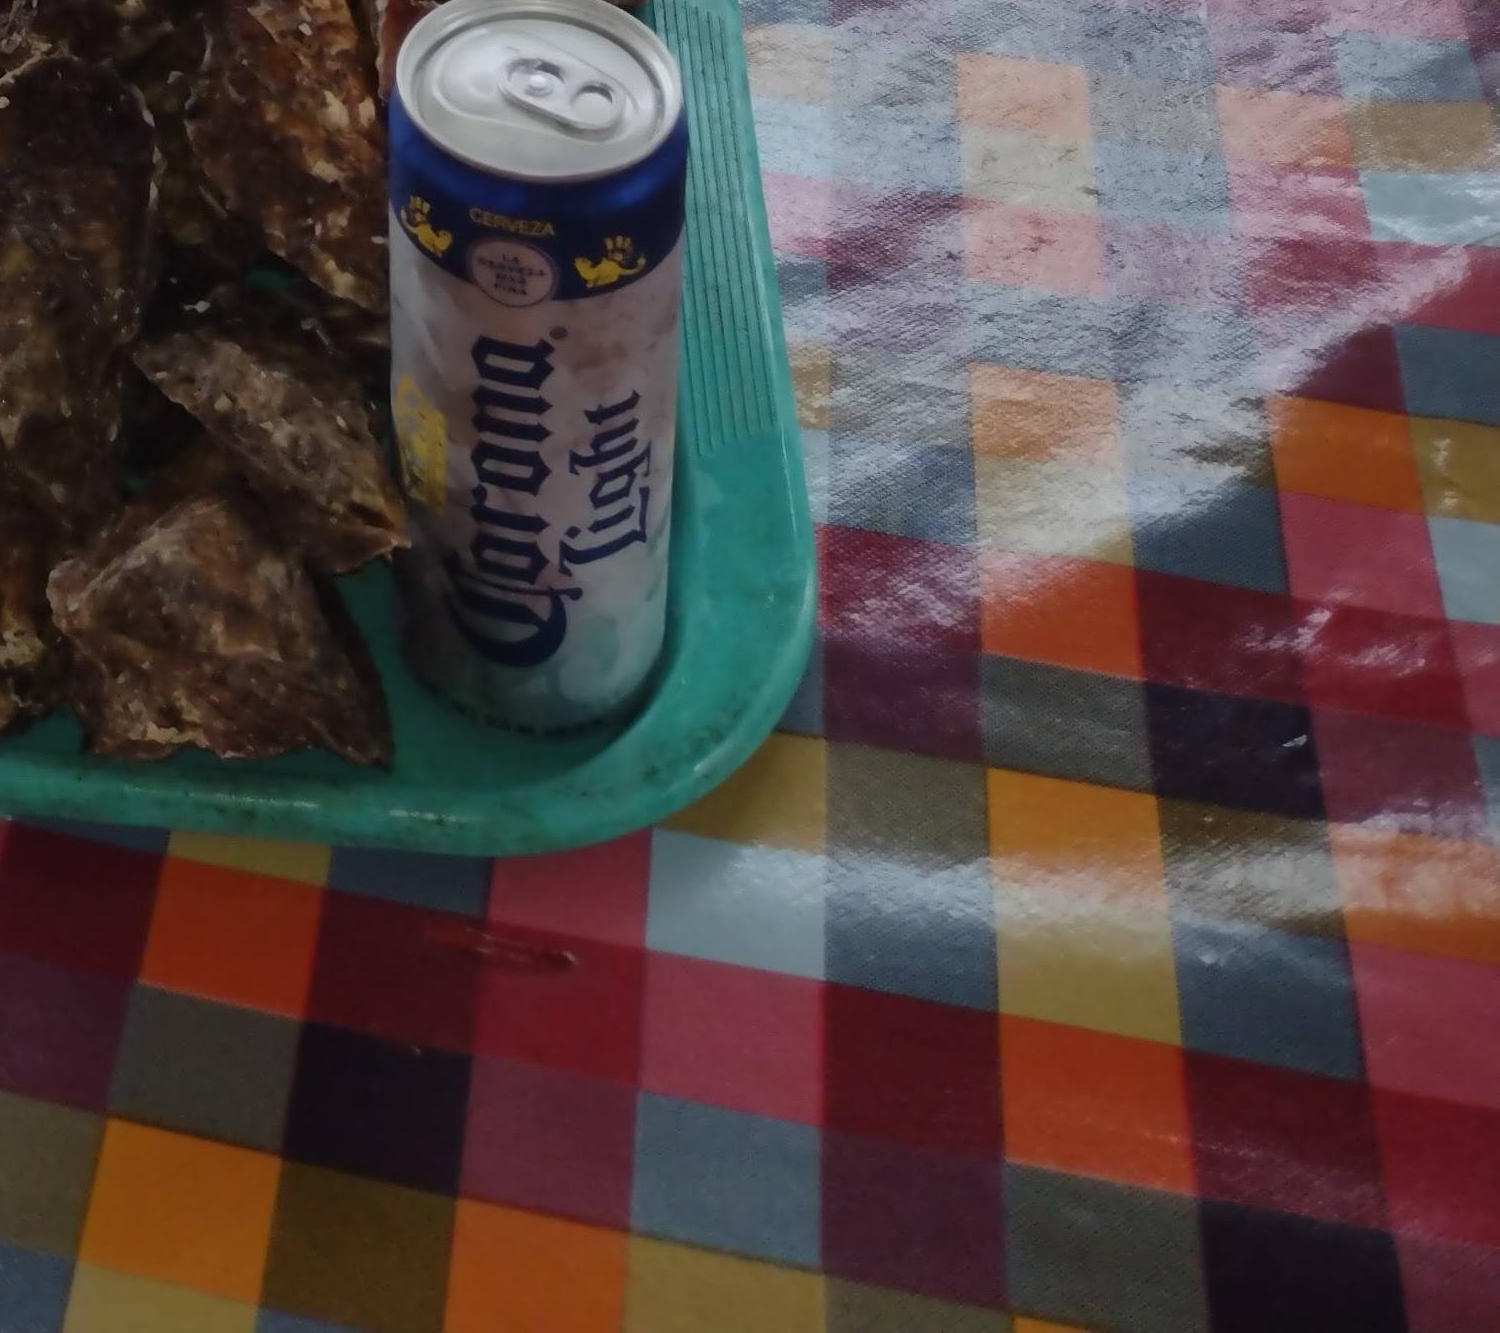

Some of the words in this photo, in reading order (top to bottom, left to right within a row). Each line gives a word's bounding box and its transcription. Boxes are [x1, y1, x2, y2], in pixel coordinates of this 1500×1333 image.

[469, 207, 556, 237] CERVEZA
[443, 334, 583, 667] Corona
[559, 388, 651, 576] Light
